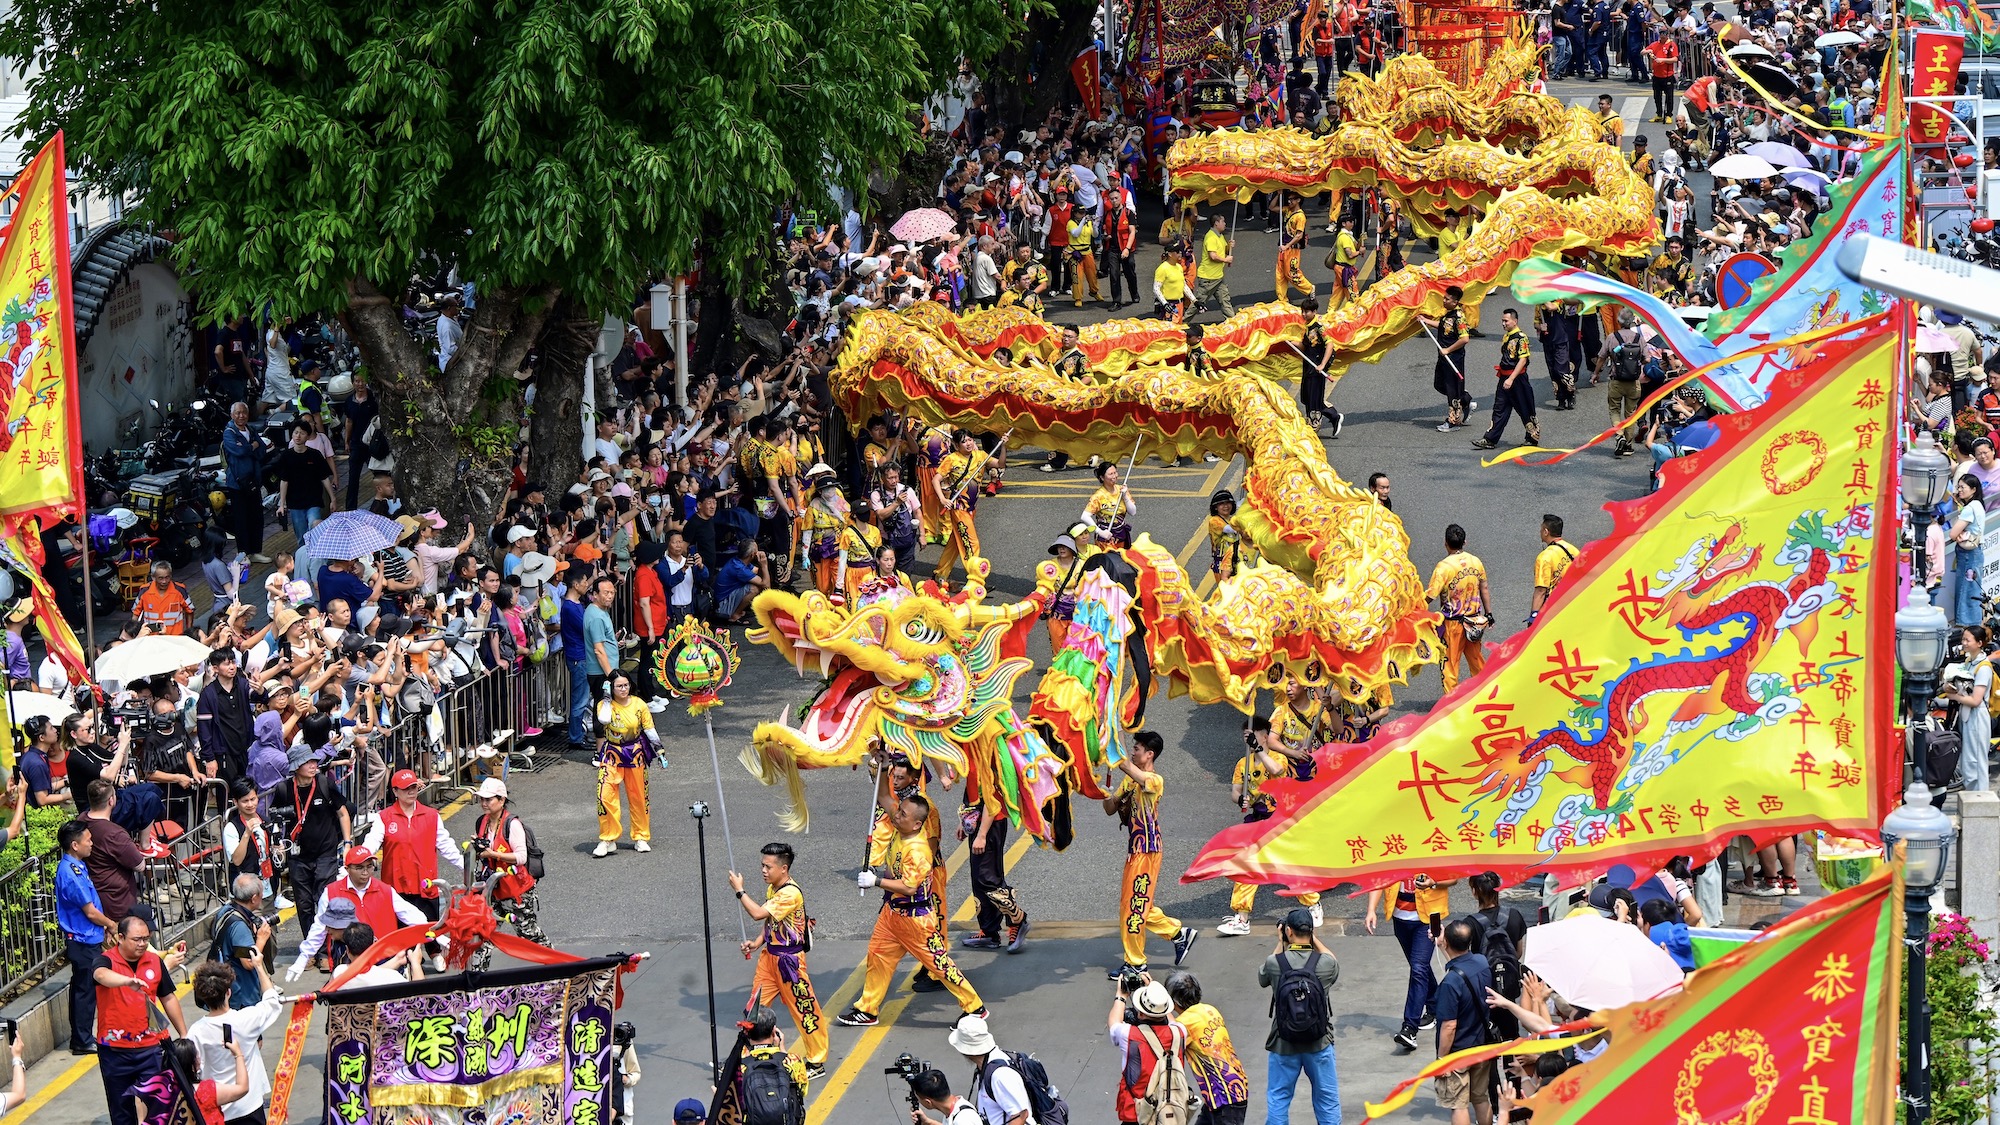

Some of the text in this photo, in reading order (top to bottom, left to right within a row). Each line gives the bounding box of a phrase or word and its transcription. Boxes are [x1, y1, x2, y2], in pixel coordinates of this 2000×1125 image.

[1921, 44, 1951, 138] 王老吉
[1128, 873, 1151, 933] 清河堂
[405, 1004, 531, 1069] 深圳
[793, 978, 819, 1034] 清河堂
[339, 1054, 366, 1124] 河水
[573, 1020, 605, 1125] 清造宗
